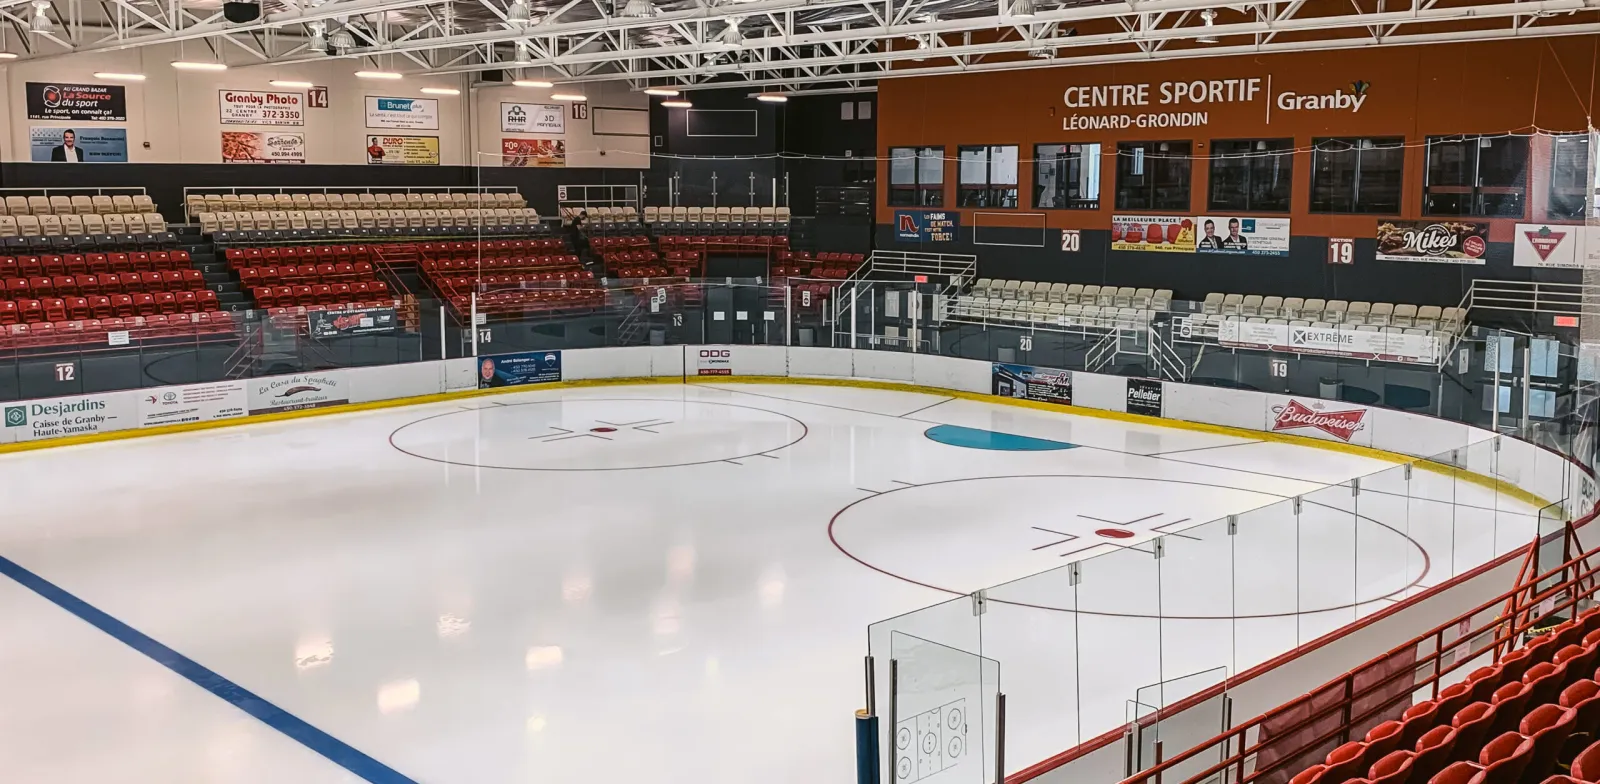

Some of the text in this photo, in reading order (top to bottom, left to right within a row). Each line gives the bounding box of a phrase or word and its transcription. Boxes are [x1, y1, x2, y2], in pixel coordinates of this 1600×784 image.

[225, 93, 298, 105] Granby Photo
[310, 91, 327, 107] 14
[1064, 78, 1260, 108] CENTRE SPORTIF
[1277, 90, 1366, 112] Granby
[574, 104, 586, 118] 16
[1063, 112, 1208, 130] LÉONARD-GRONDIN
[1062, 234, 1079, 251] 20
[1403, 229, 1457, 253] Mikes
[1331, 243, 1352, 263] 19
[480, 332, 491, 343] 14
[1020, 339, 1032, 351] 20
[1308, 331, 1353, 344] EXTRÊME
[57, 366, 74, 381] 12
[1273, 363, 1287, 377] 19
[1128, 388, 1160, 401] Pelletier
[32, 399, 105, 417] Desjardins
[33, 420, 59, 429] Caisse
[75, 414, 105, 424] Granby
[1272, 405, 1364, 430] Budweiser
[34, 424, 98, 437] Haute-Yamaska
